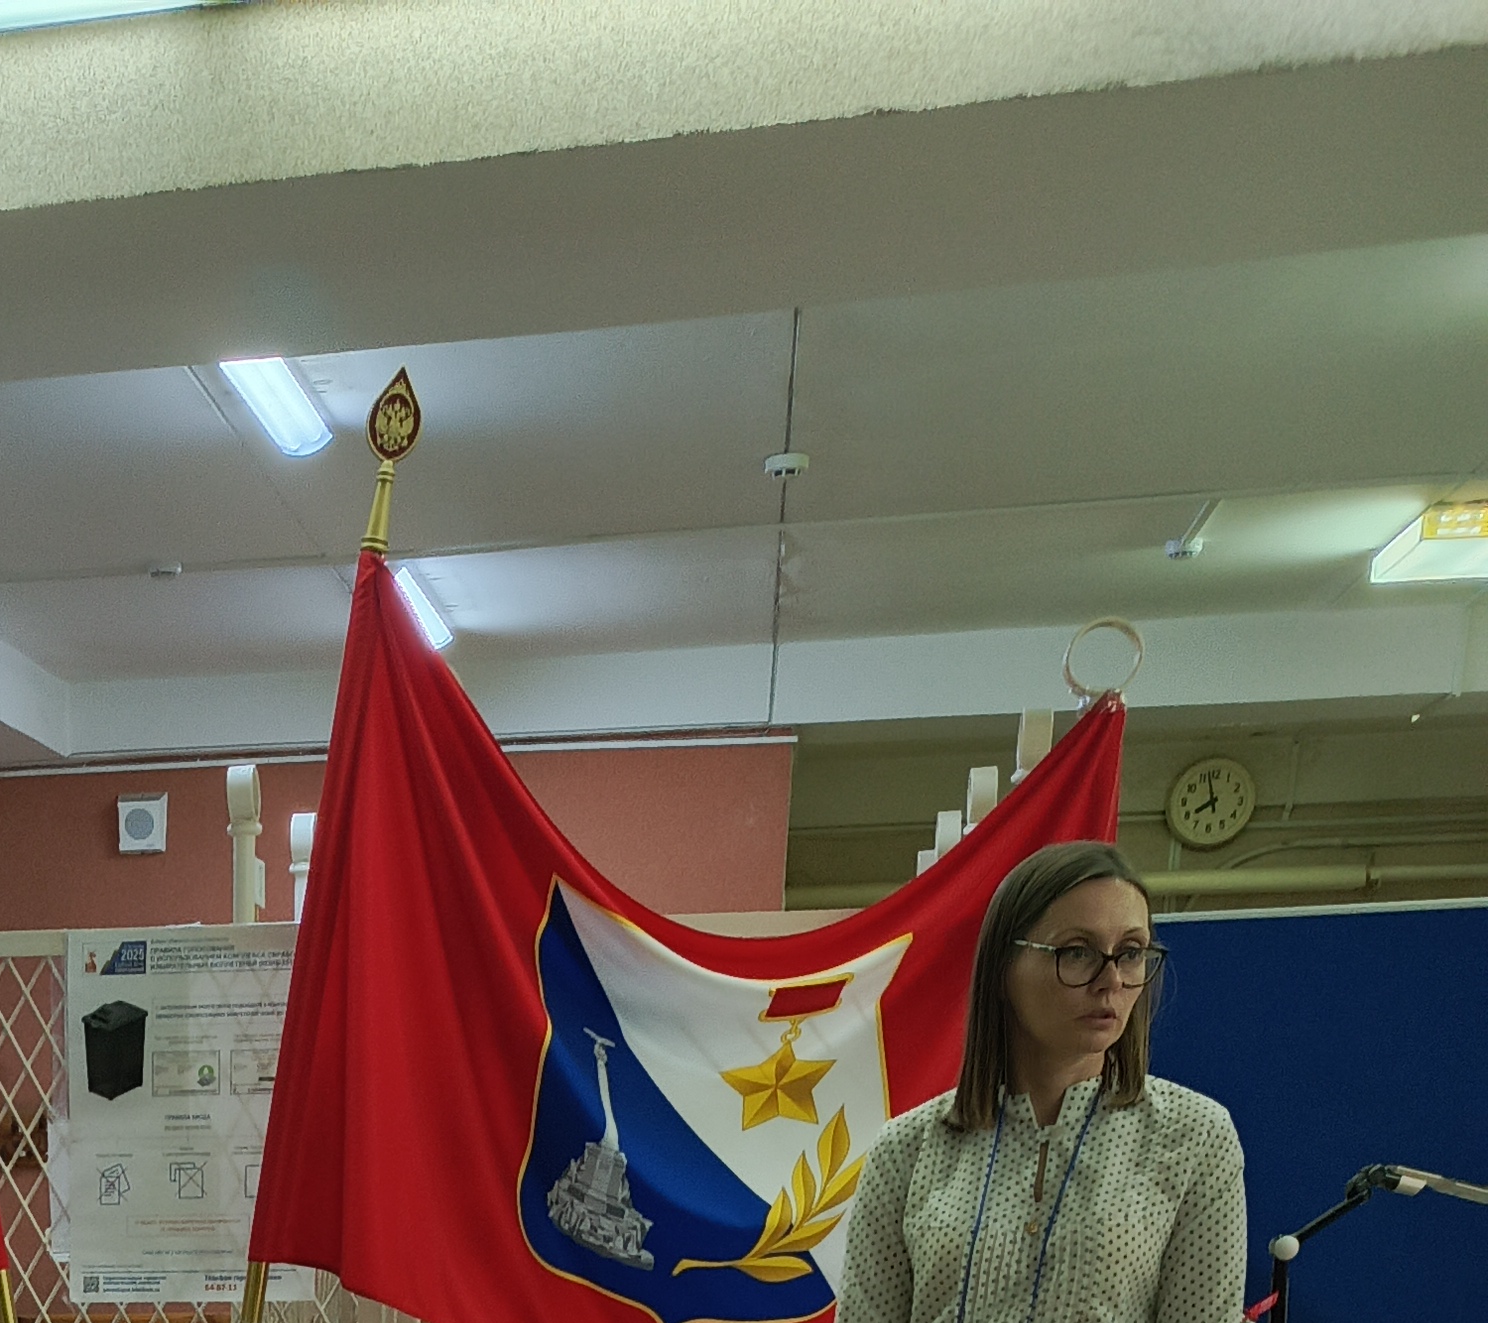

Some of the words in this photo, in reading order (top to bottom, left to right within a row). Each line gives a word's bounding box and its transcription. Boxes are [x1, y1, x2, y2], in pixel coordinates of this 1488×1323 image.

[1199, 773, 1207, 783] 11
[1211, 769, 1221, 780] 12
[1227, 772, 1231, 782] 1
[1187, 783, 1197, 793] 10
[1234, 783, 1240, 793] 2
[1181, 797, 1187, 807] 9
[1237, 796, 1243, 806] 3
[1184, 811, 1190, 820] 8
[1230, 809, 1237, 820] 4
[1193, 820, 1200, 830] 7
[1205, 823, 1212, 833] 6
[1219, 820, 1225, 829] 5
[121, 948, 145, 962] 2025
